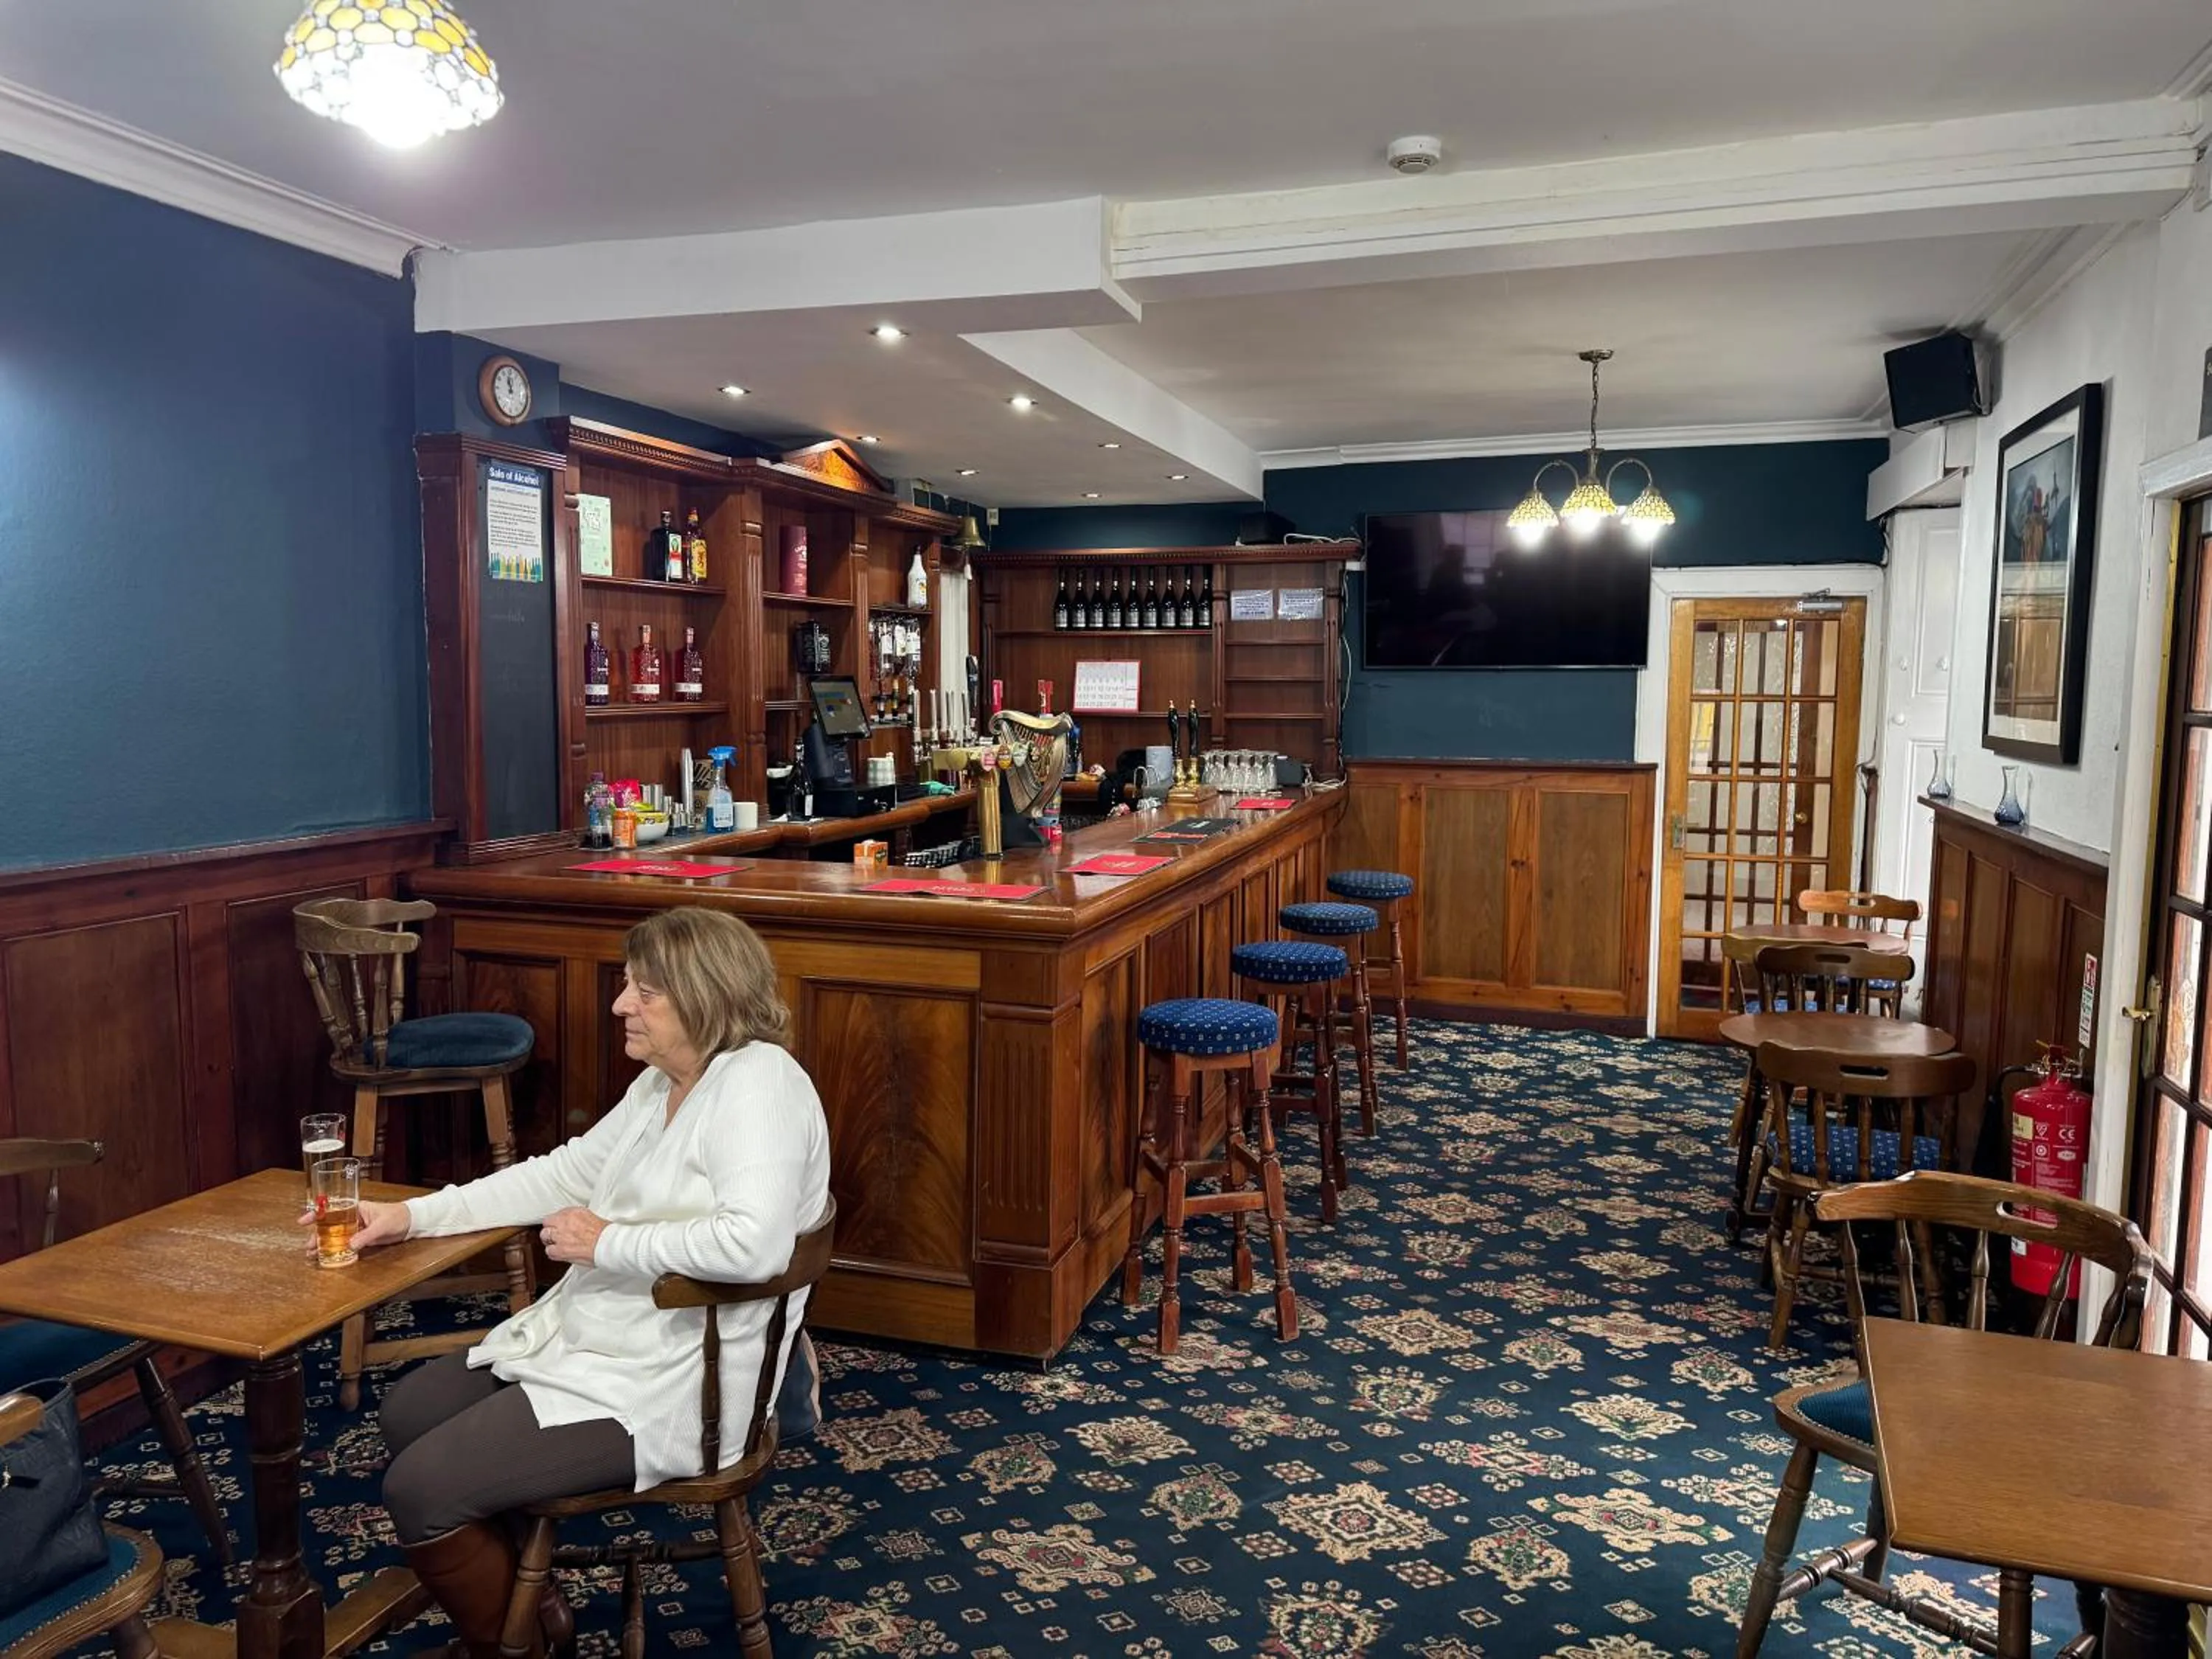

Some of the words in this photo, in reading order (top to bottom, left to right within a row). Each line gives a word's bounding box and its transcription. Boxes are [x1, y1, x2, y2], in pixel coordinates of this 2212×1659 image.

[489, 467, 505, 479] Sale
[506, 471, 512, 480] of
[514, 472, 539, 485] Alcohol
[2058, 1128, 2076, 1141] CE
